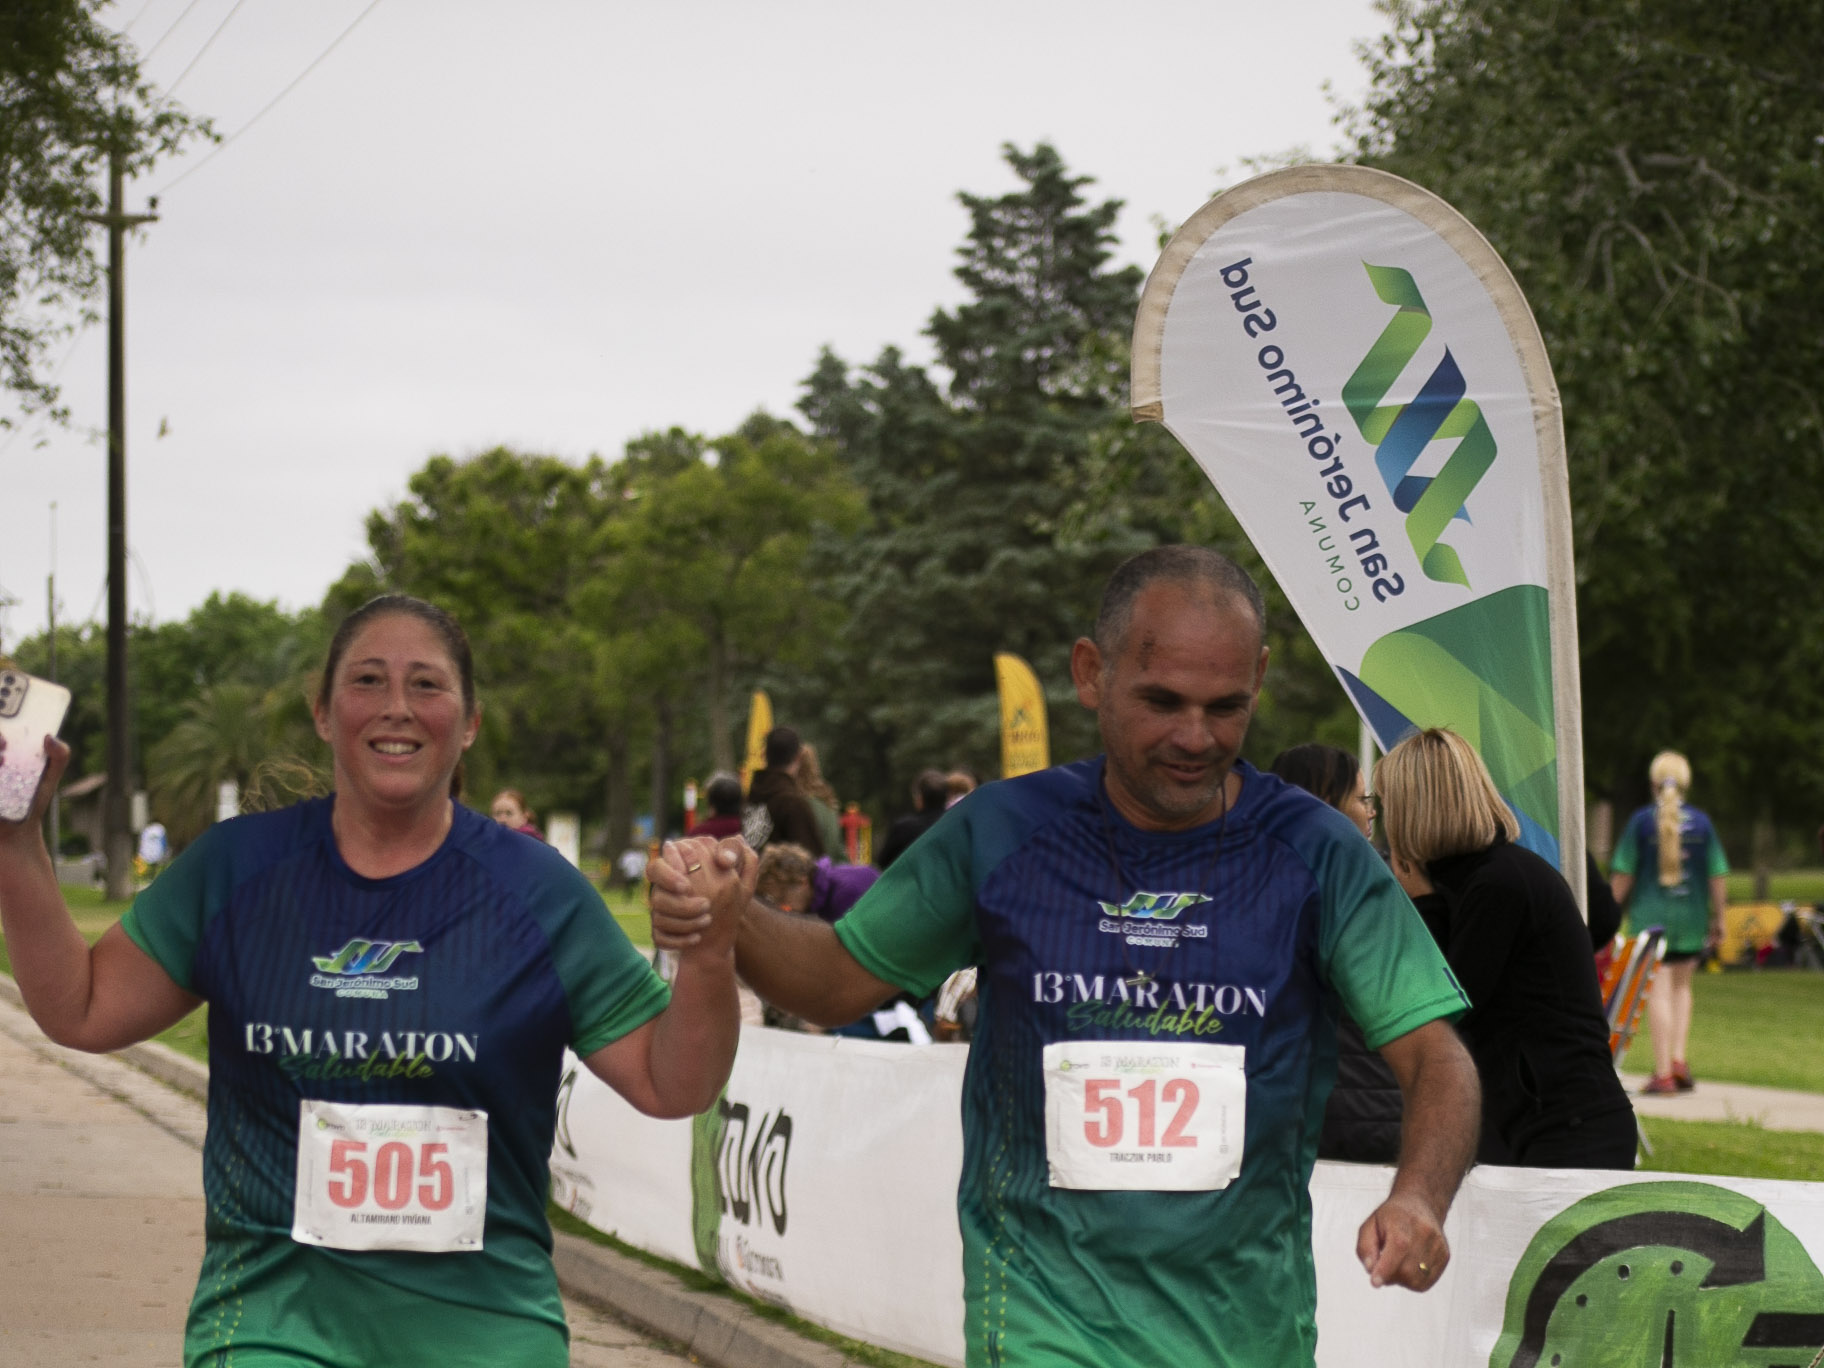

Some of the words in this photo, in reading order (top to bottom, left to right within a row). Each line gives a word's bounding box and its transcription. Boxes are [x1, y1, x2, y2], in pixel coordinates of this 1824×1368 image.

[1182, 925, 1207, 937] Sud
[393, 977, 418, 989] Sud
[1073, 974, 1266, 1017] MARATON
[1066, 1000, 1224, 1035] Saludable
[282, 1027, 479, 1063] MARATON
[278, 1050, 434, 1081] Saludable
[1084, 1079, 1199, 1148] 512
[328, 1139, 455, 1211] 505
